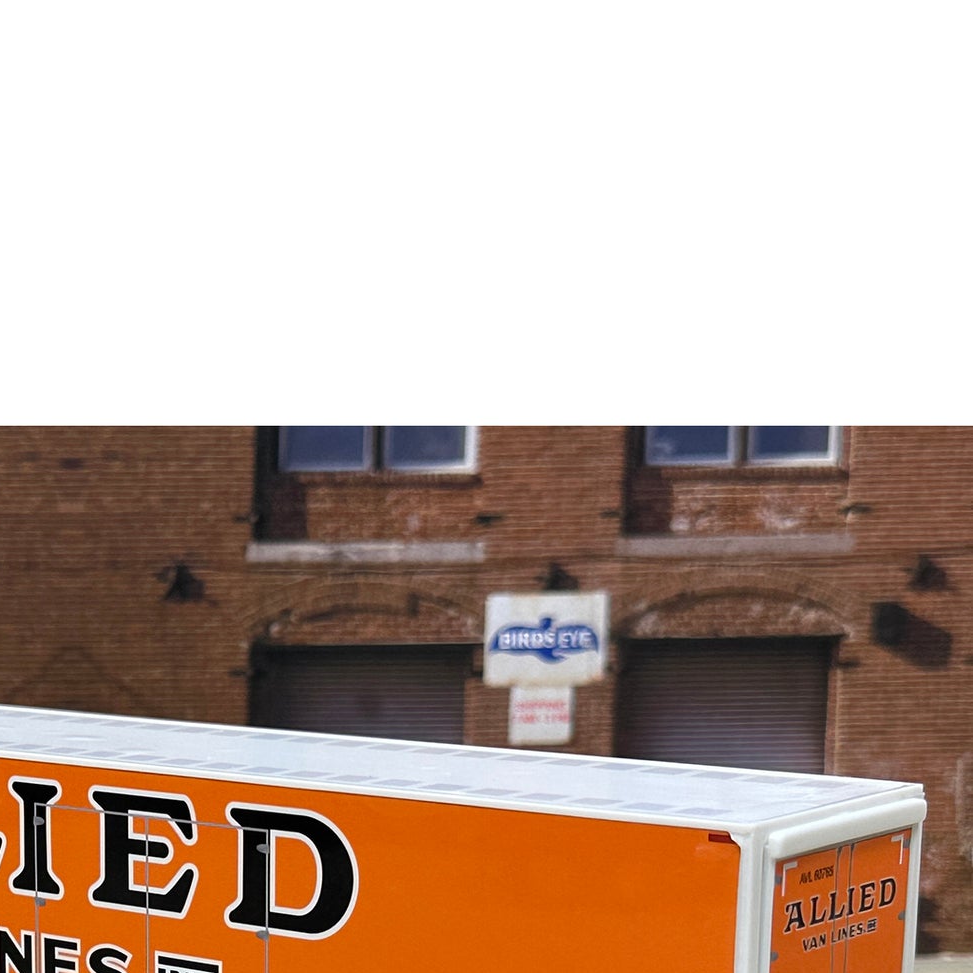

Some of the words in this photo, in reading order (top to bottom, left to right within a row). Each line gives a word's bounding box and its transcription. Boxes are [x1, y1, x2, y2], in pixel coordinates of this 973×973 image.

[799, 870, 813, 885] AVL
[784, 876, 897, 934] ALLIED
[802, 933, 827, 952] VAN
